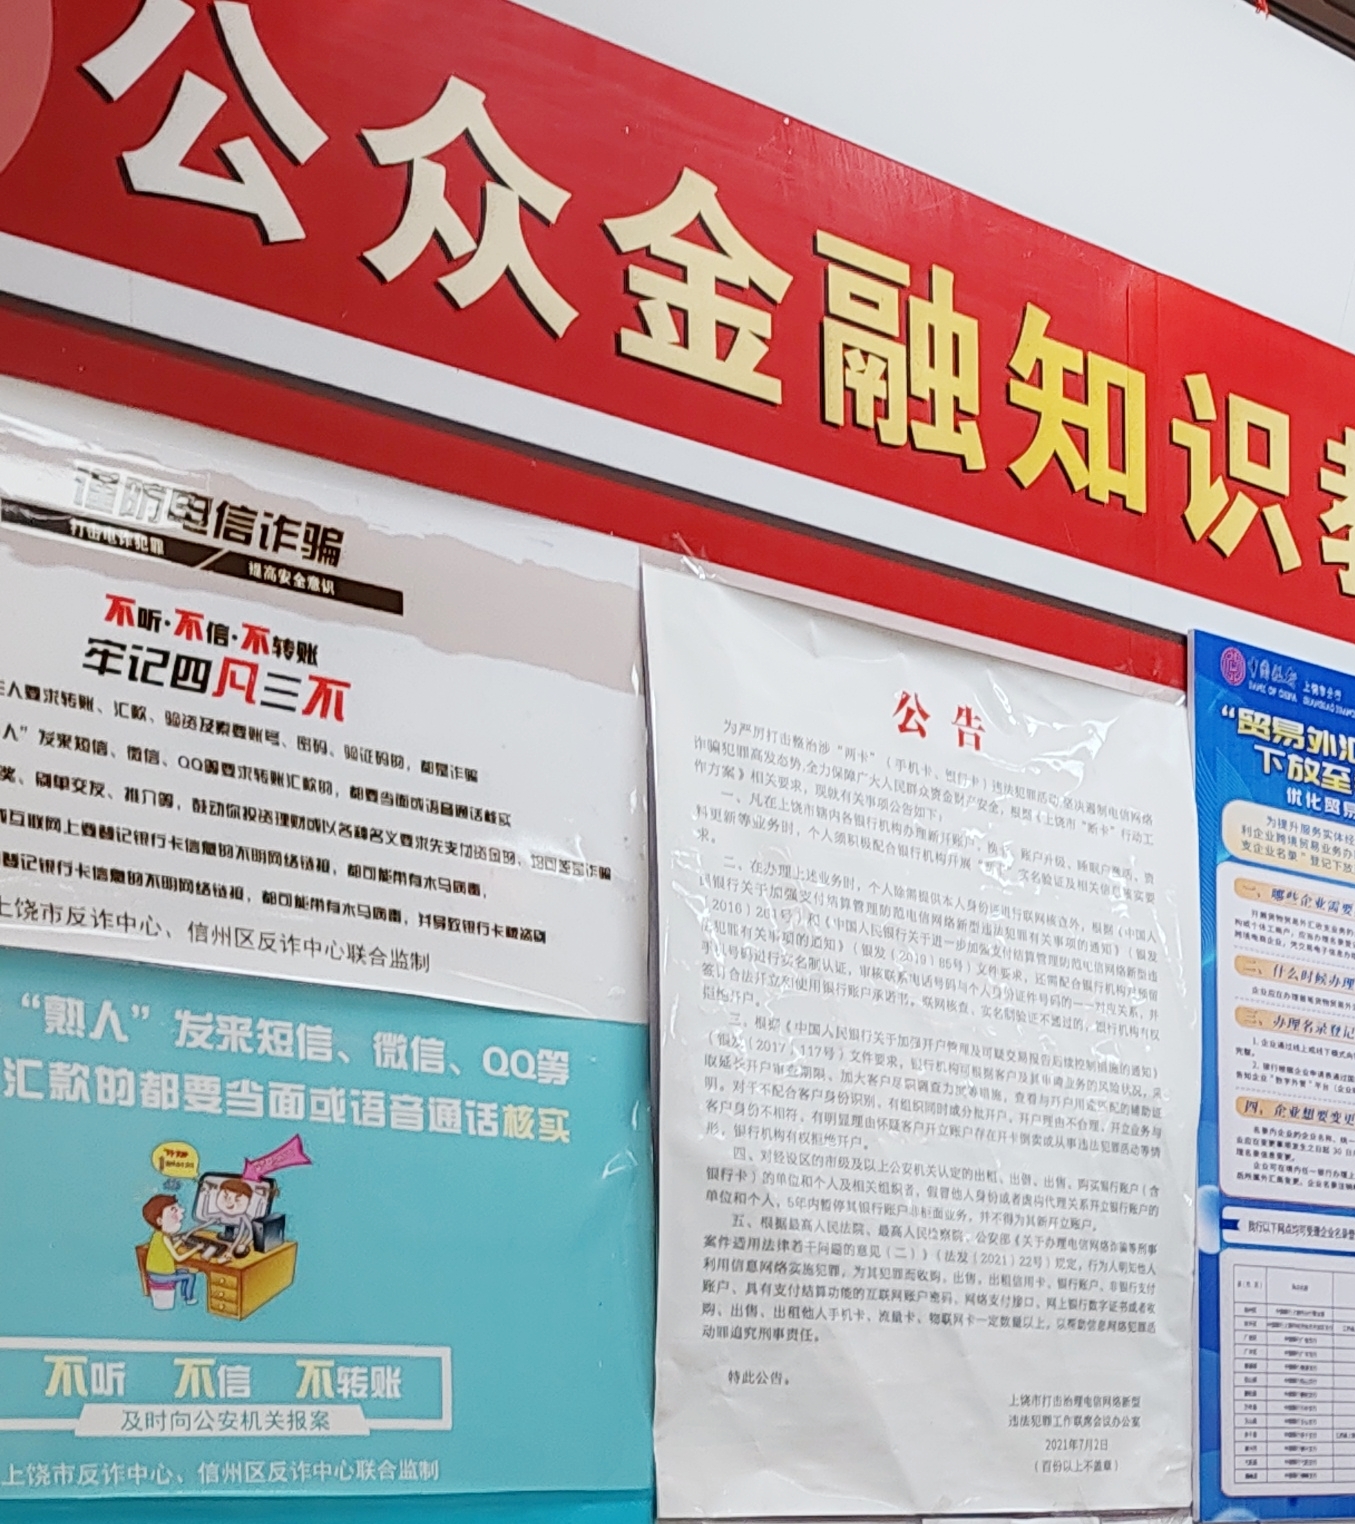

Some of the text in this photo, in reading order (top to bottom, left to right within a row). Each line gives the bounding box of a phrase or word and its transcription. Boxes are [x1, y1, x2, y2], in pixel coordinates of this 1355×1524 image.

[249, 562, 335, 596] 提高安全意识
[82, 637, 352, 722] 牢记四凡三不
[892, 691, 987, 751] 公告
[3, 1059, 571, 1145] 汇款的都要当面或语音通话核实
[43, 1355, 401, 1400] 不听 不信 不转账
[120, 1410, 330, 1433] 及时向公安机关报案
[1046, 1437, 1108, 1452] 2021年7月2日
[2, 1459, 439, 1486] 上饶市反诈中心、信州区反诈中心联合监制
